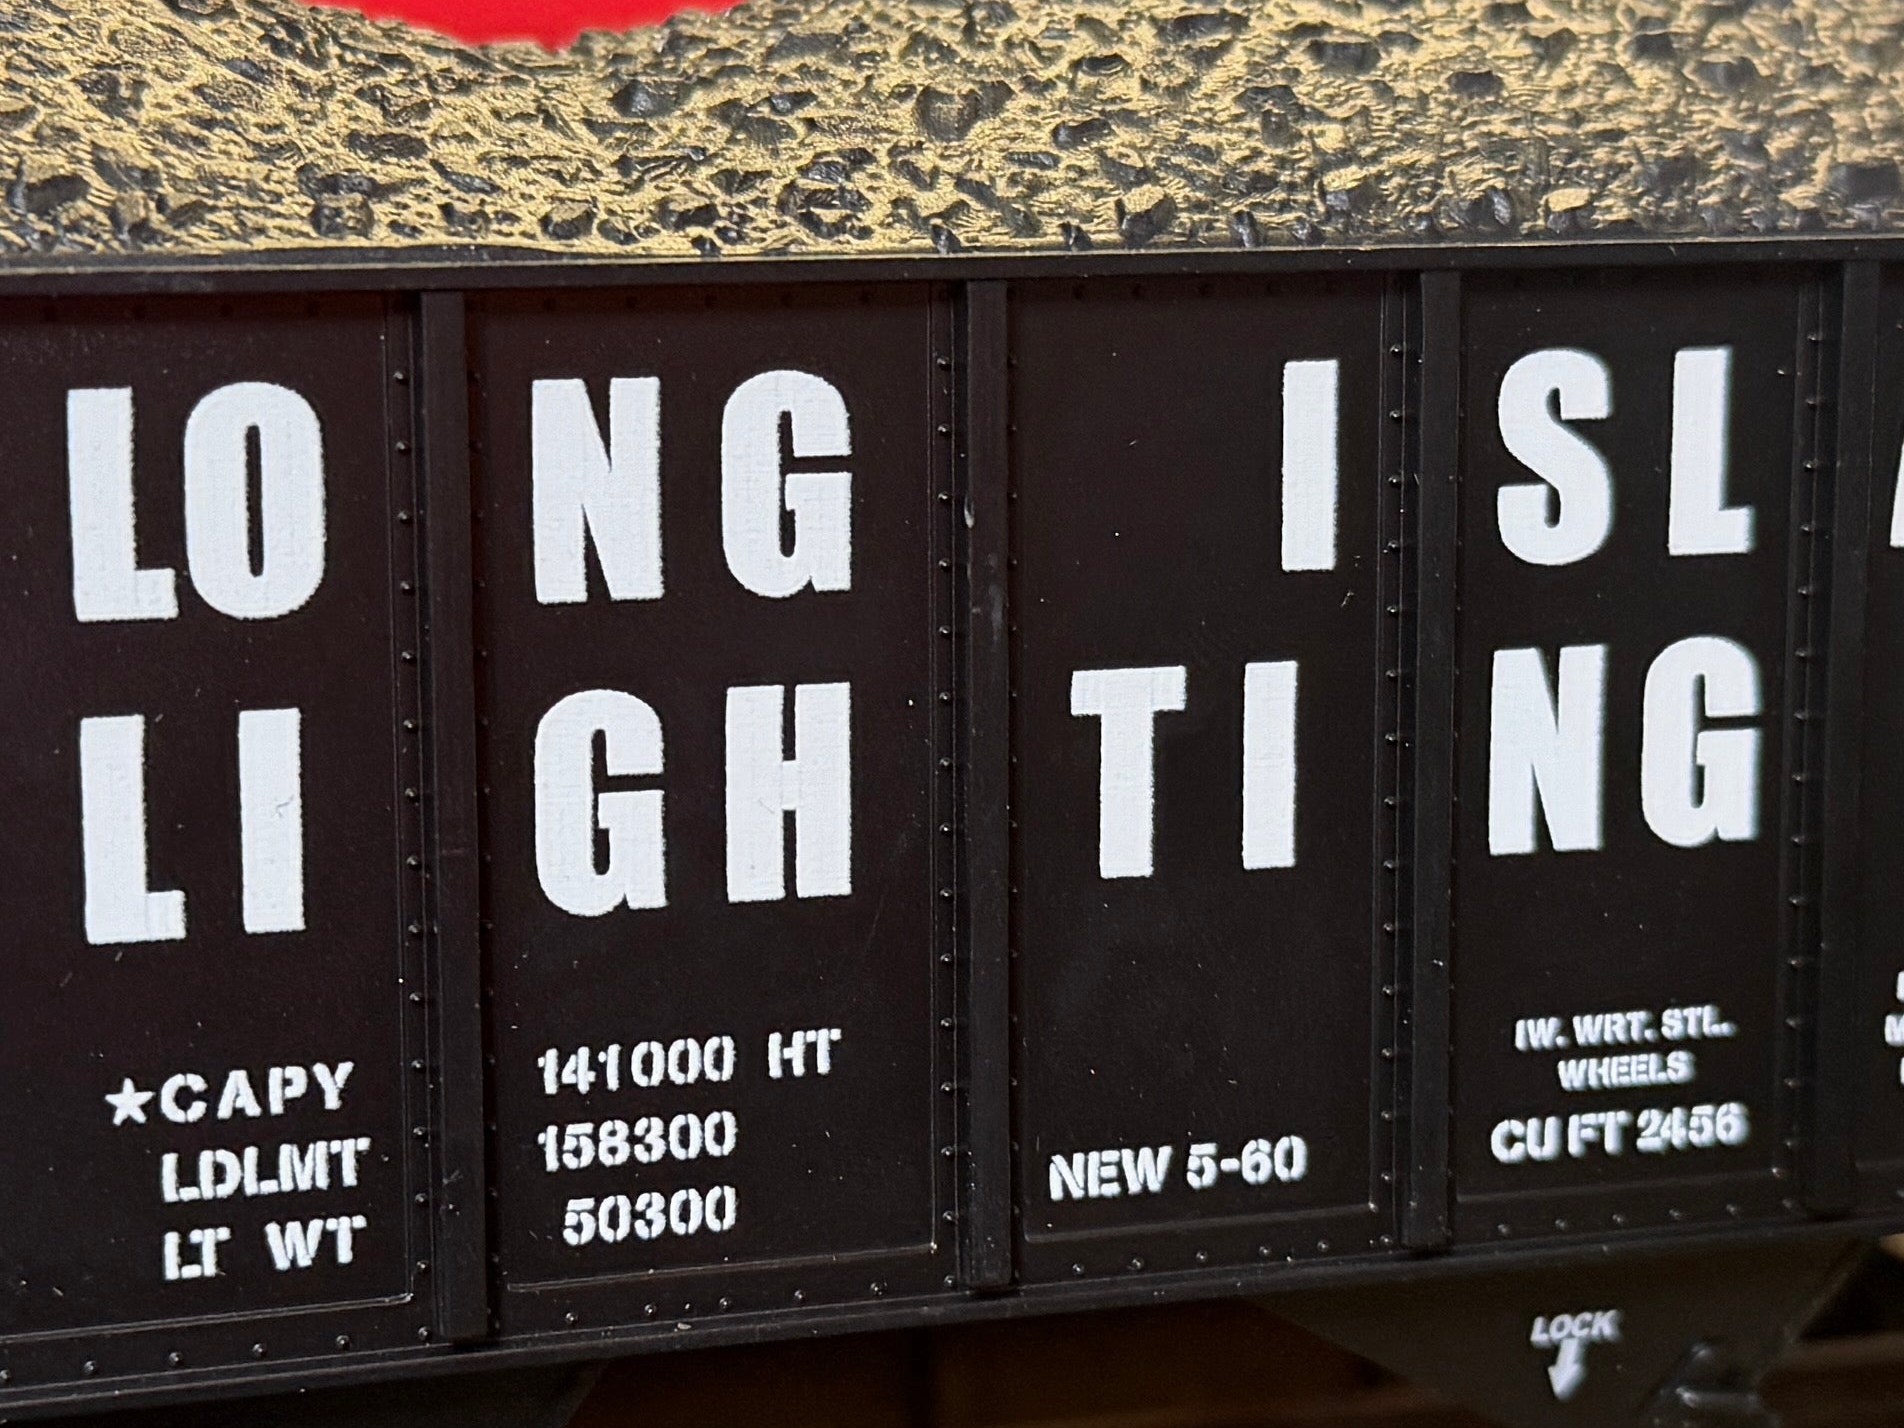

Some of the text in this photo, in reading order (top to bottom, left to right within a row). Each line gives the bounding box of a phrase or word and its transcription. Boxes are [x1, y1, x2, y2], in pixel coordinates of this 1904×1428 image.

[1572, 1011, 1658, 1047] WRT.
[538, 1028, 842, 1096] 141000 HT
[1557, 1050, 1696, 1092] WHEELS
[538, 1110, 739, 1173] 158300
[1490, 1102, 1750, 1164] CU FT 2456
[161, 1136, 371, 1205] LDLMT
[1049, 1135, 1309, 1201] NEW 5-60
[562, 1185, 740, 1247] 50300
[163, 1214, 368, 1282] LT WT
[1530, 1307, 1622, 1346] LOCK
